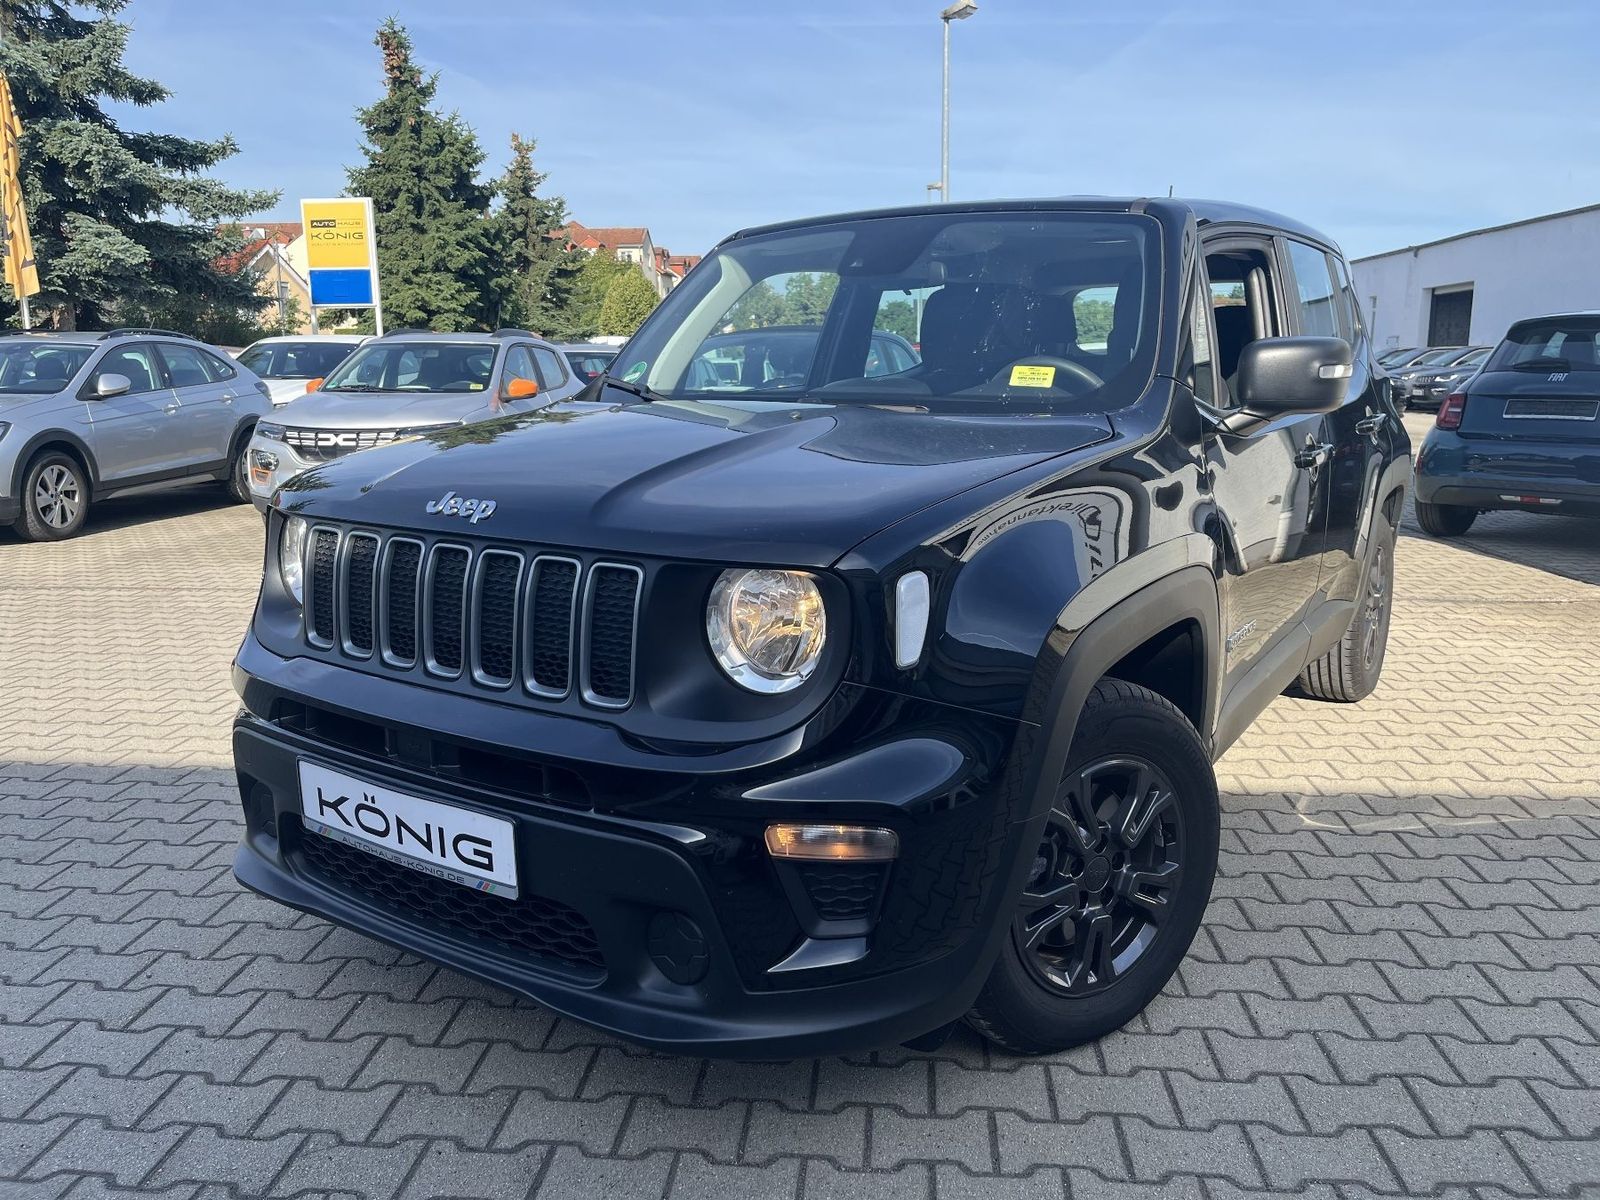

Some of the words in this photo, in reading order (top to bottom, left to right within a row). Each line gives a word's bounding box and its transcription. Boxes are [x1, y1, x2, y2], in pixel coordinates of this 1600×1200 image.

[311, 230, 364, 240] KÖNIG
[1547, 373, 1568, 381] FIAT
[426, 491, 497, 524] Jeep
[316, 787, 494, 873] KÖNIG
